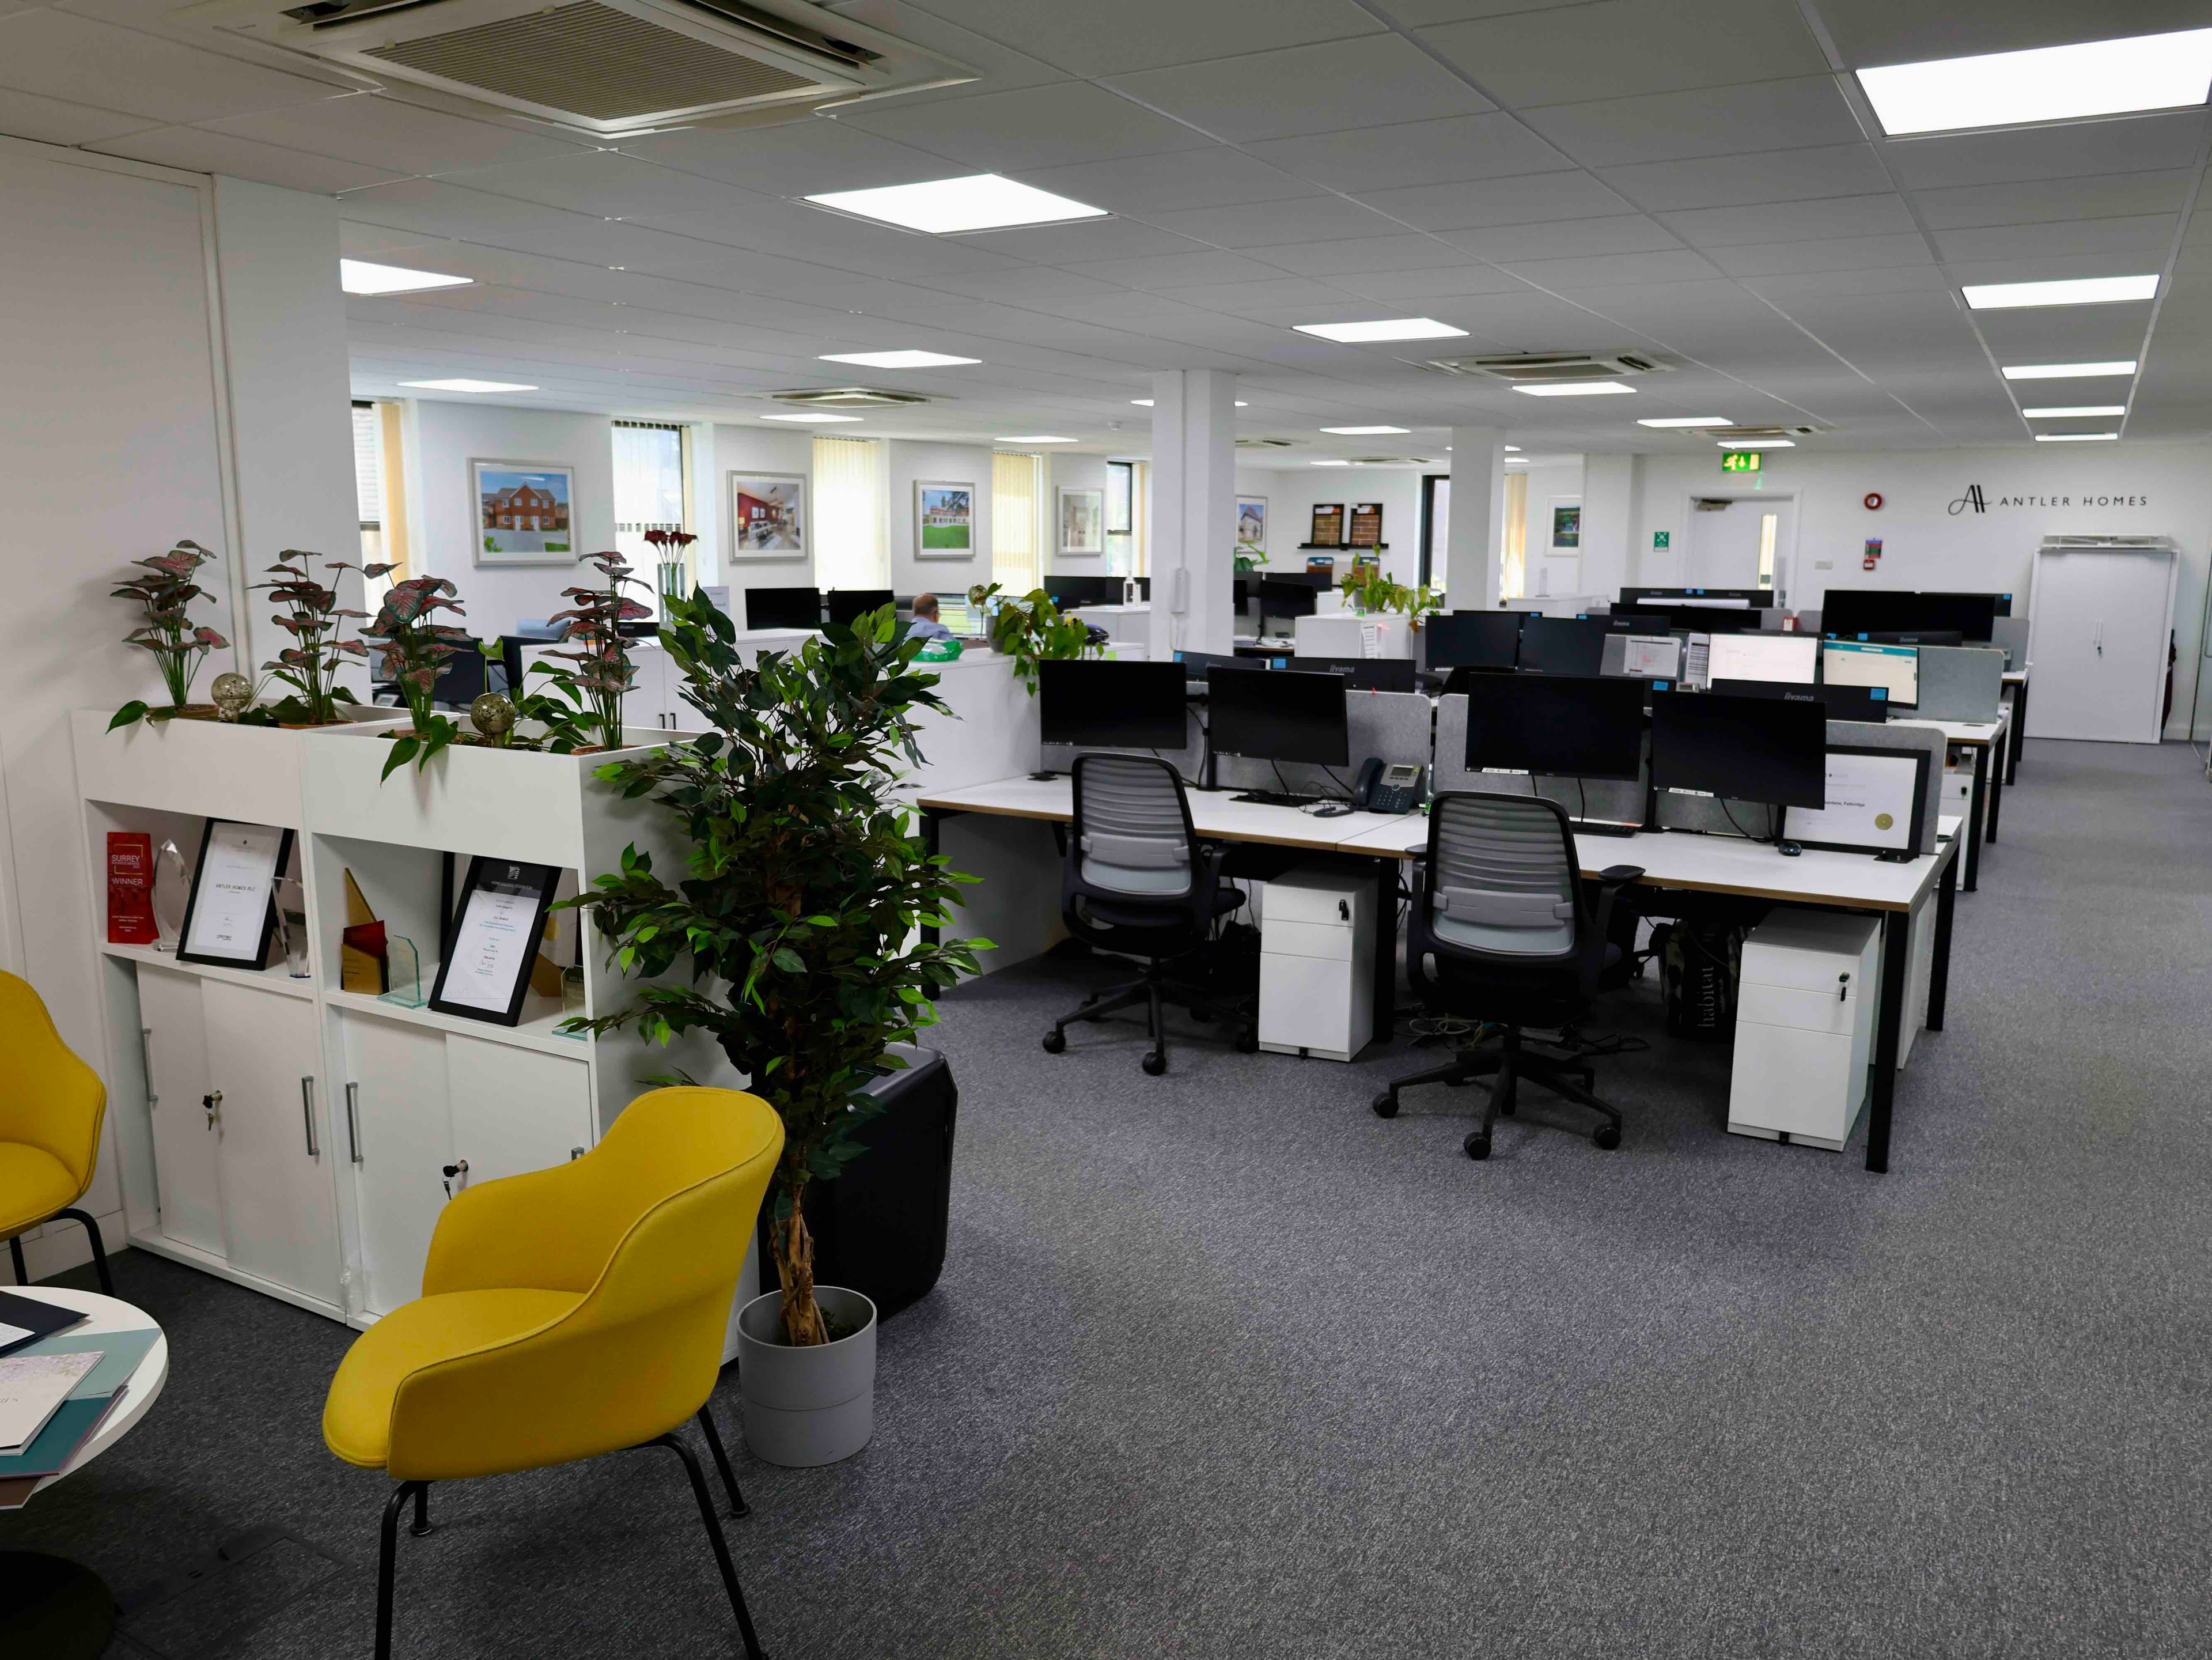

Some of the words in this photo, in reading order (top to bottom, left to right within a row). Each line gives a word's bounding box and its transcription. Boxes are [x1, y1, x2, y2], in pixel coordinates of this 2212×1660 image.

[1999, 497, 2070, 506] ANTLER
[2083, 496, 2147, 506] HOMES
[111, 854, 140, 863] SURREY
[1696, 966, 1715, 1028] habitat
